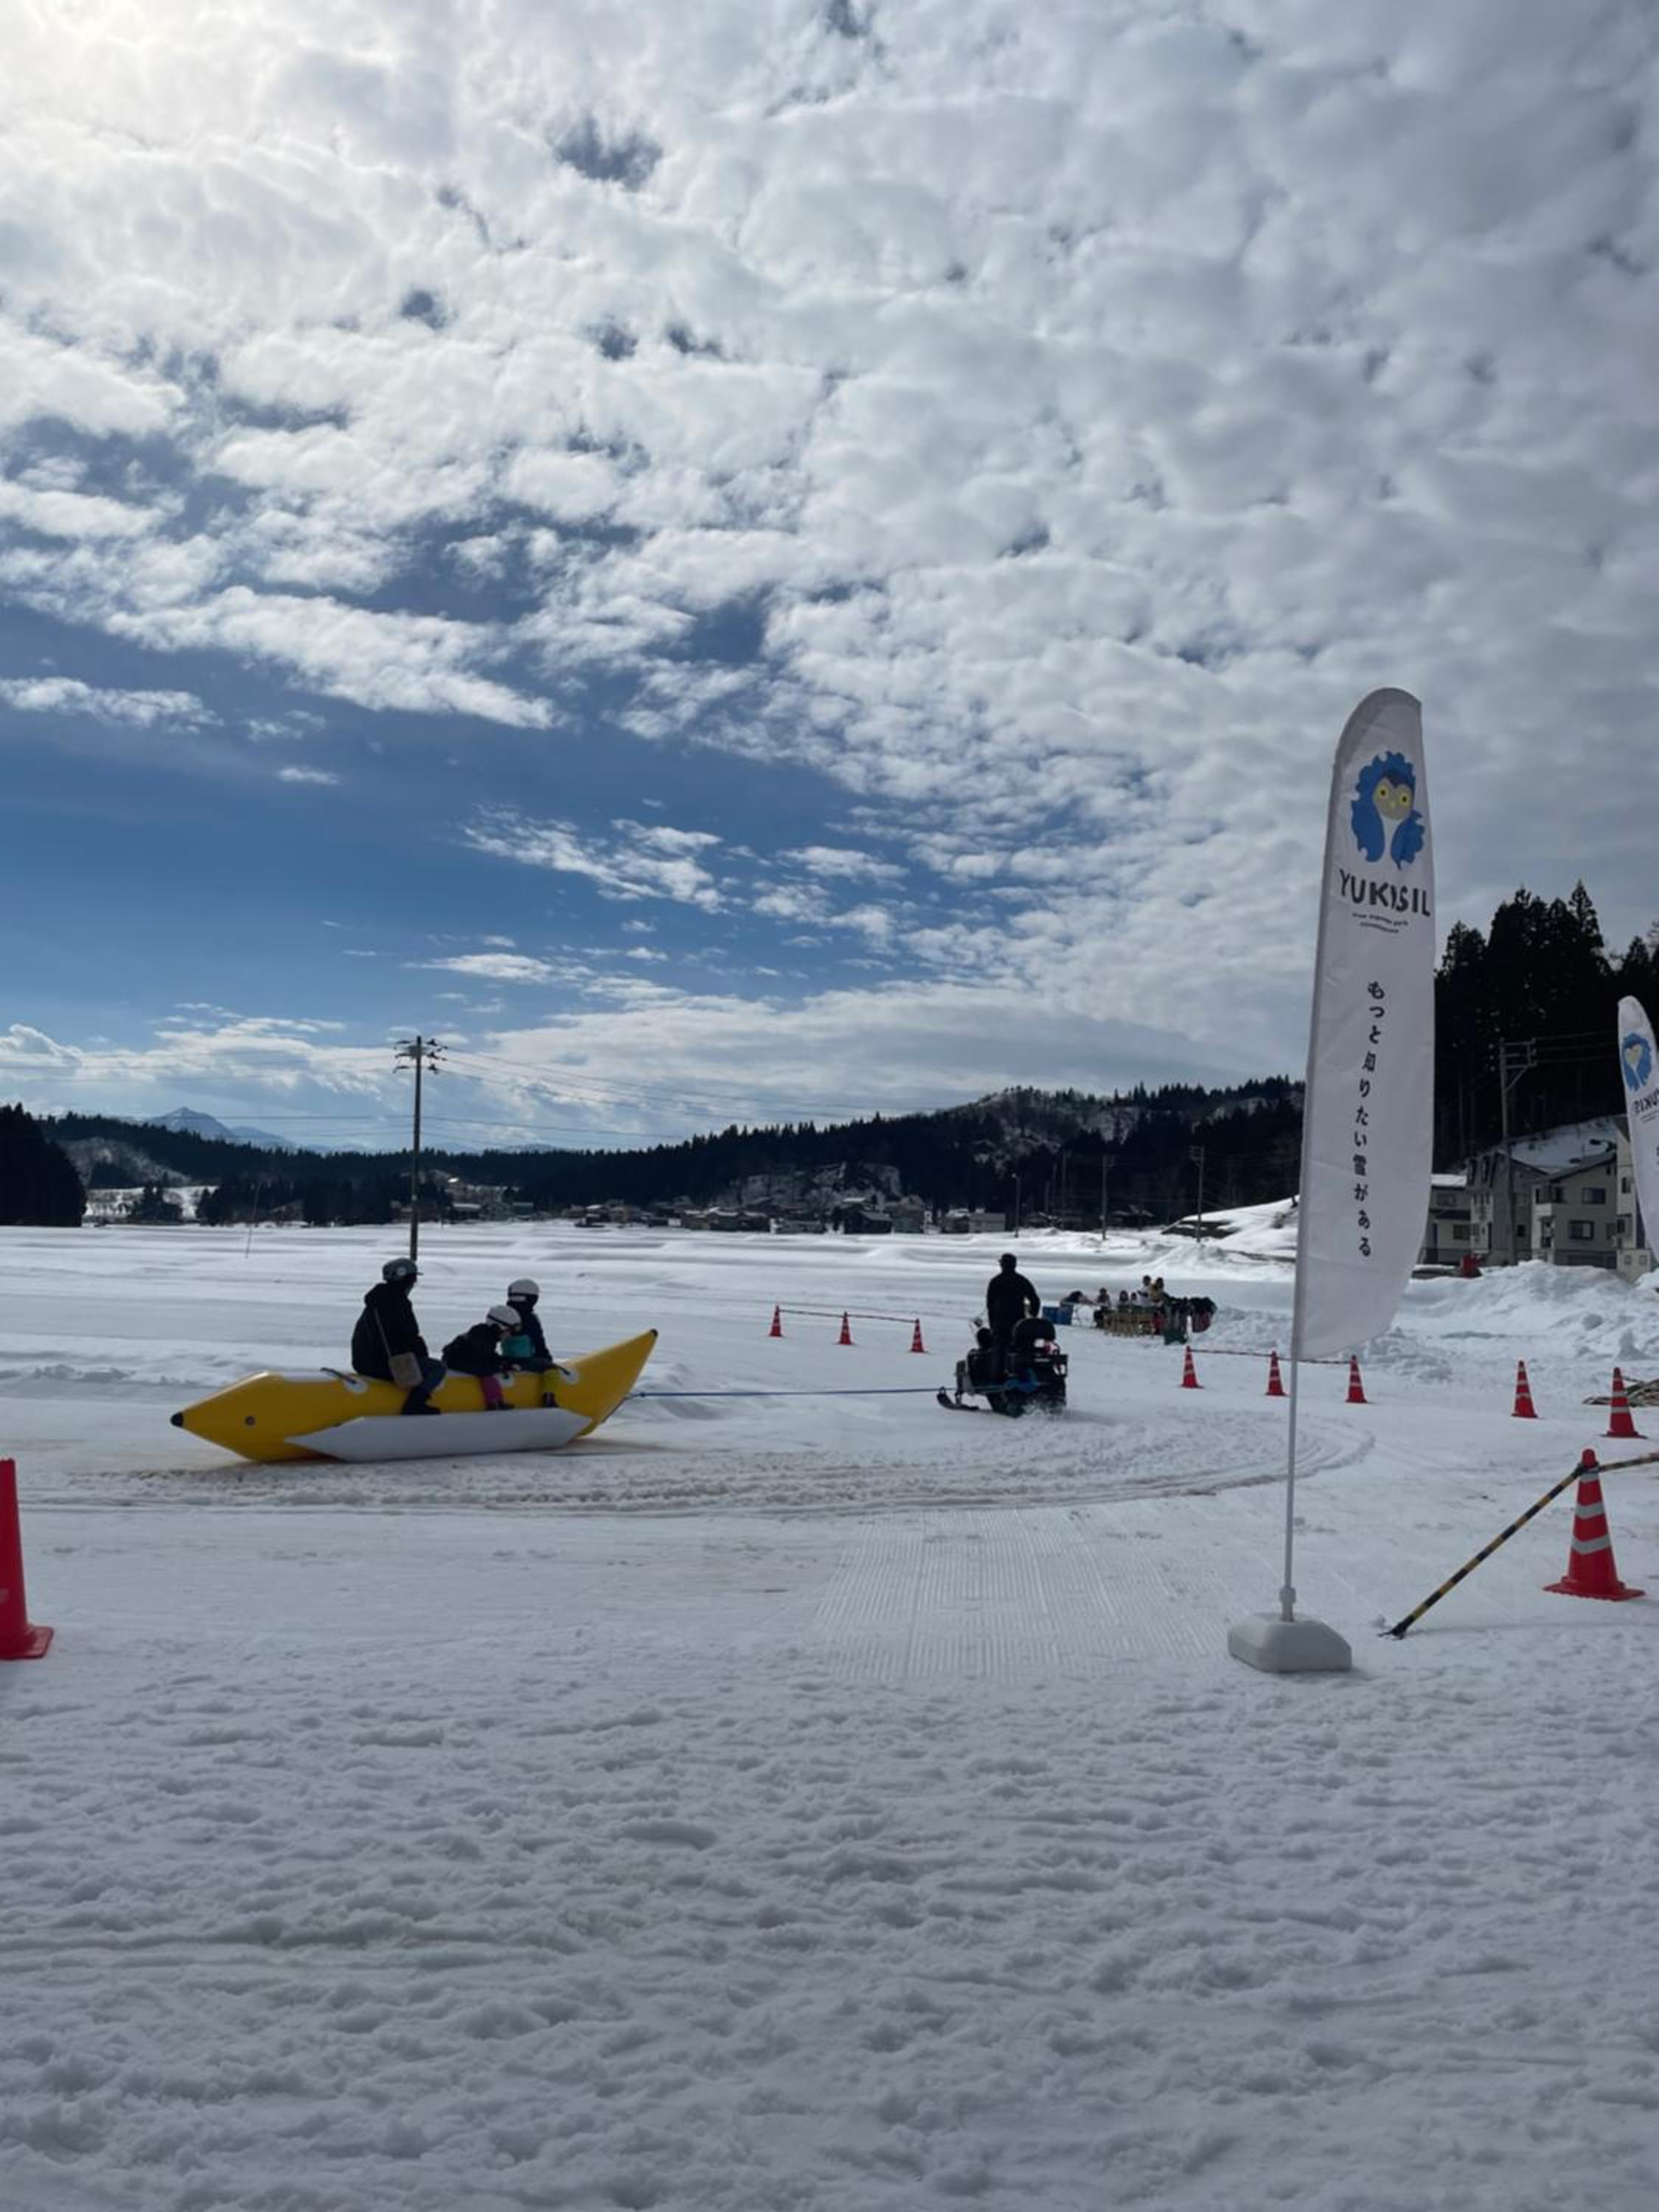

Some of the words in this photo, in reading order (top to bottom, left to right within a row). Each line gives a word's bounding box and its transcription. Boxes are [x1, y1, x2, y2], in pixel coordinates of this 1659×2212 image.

[1340, 869, 1430, 917] YUKISIL
[1353, 981, 1385, 1257] もっと知りたい雪がある
